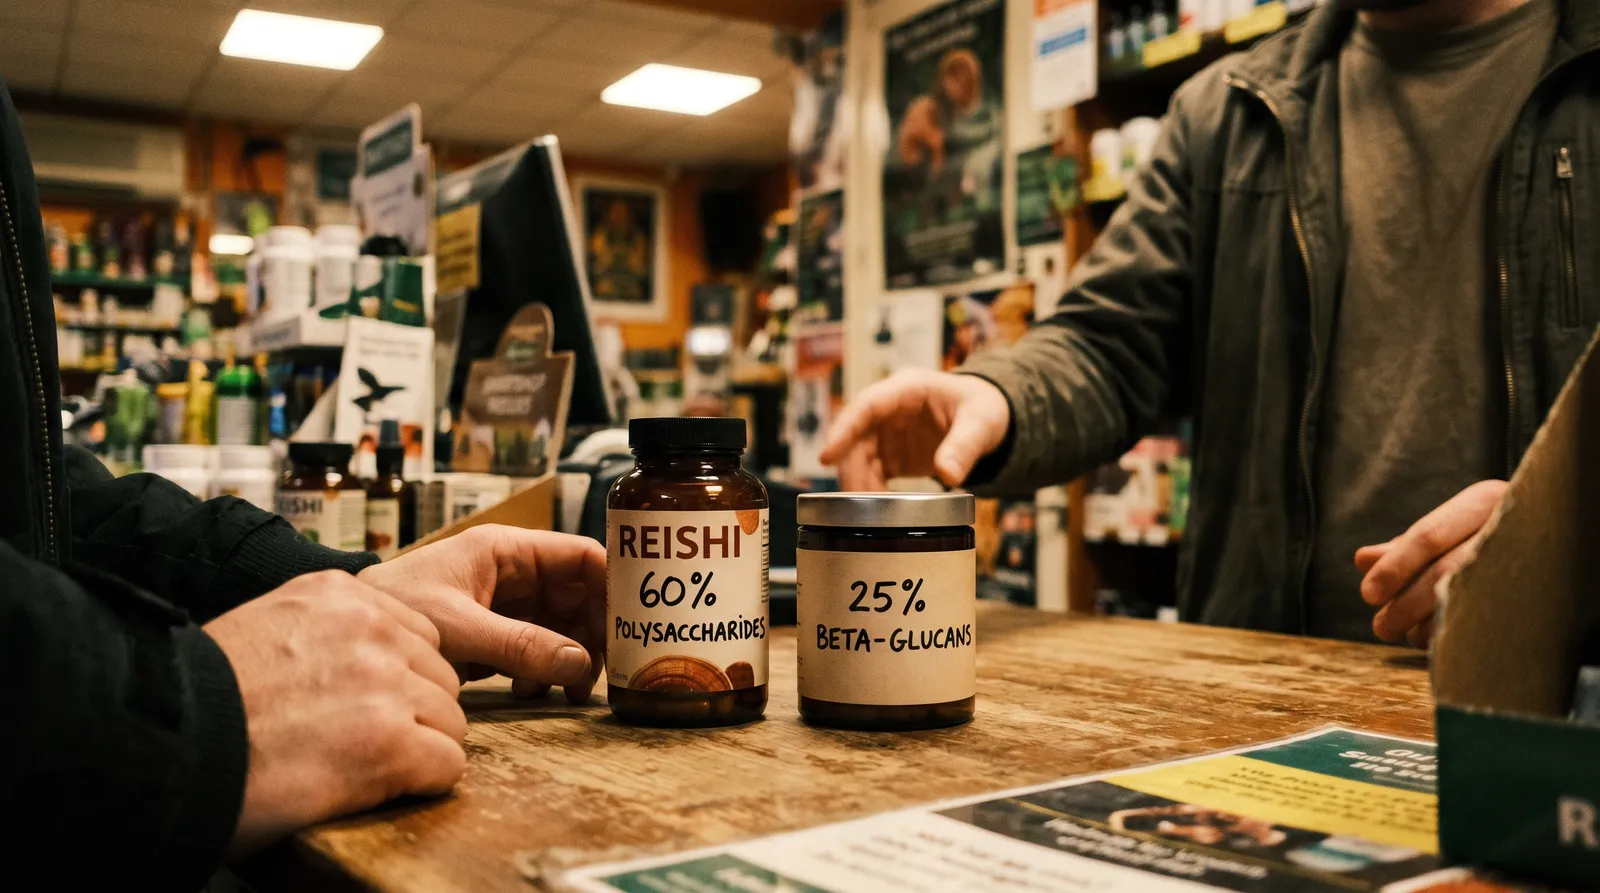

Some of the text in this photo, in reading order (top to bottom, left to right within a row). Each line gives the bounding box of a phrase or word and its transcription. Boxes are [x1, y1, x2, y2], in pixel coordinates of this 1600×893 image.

[619, 525, 741, 559] REISHI
[639, 571, 717, 609] 60%
[848, 578, 926, 616] 25%
[816, 623, 972, 653] BETA-GLUCANS
